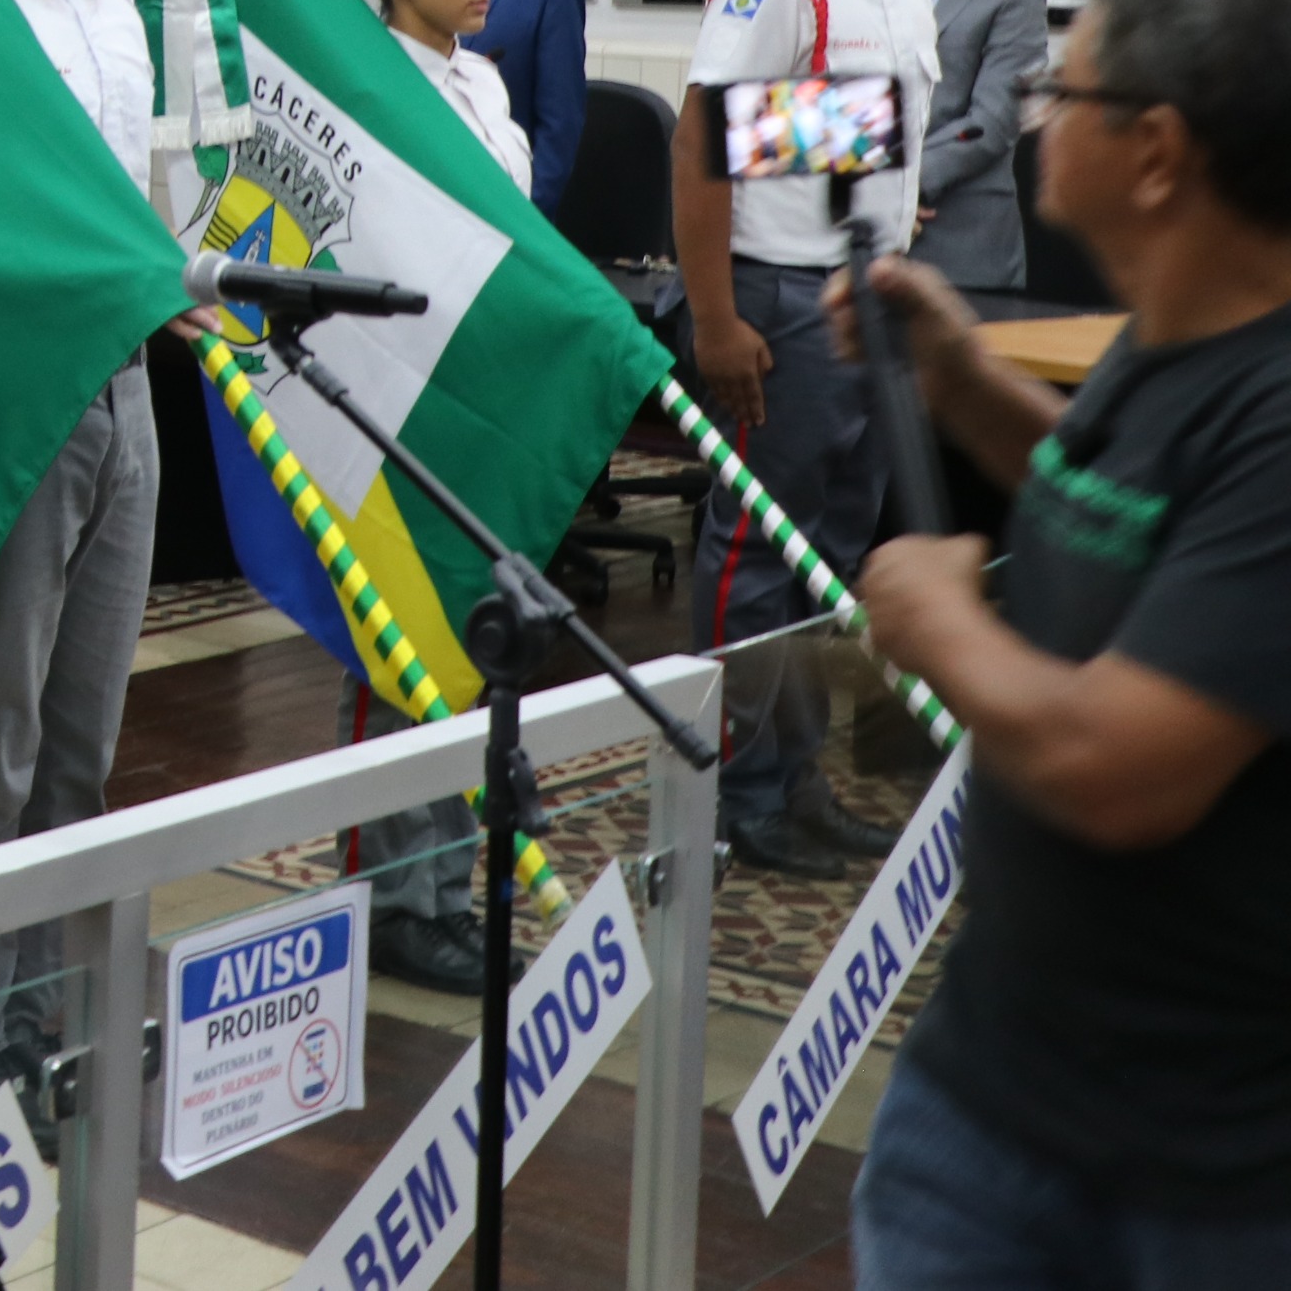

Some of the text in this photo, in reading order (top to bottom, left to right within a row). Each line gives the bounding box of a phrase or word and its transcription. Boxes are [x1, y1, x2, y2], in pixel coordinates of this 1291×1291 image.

[207, 986, 320, 1051] PROIBIDO
[208, 926, 323, 1010] AVISO
[757, 768, 972, 1177] CÂMARA MUN
[343, 913, 627, 1291] BEM VNDOS
